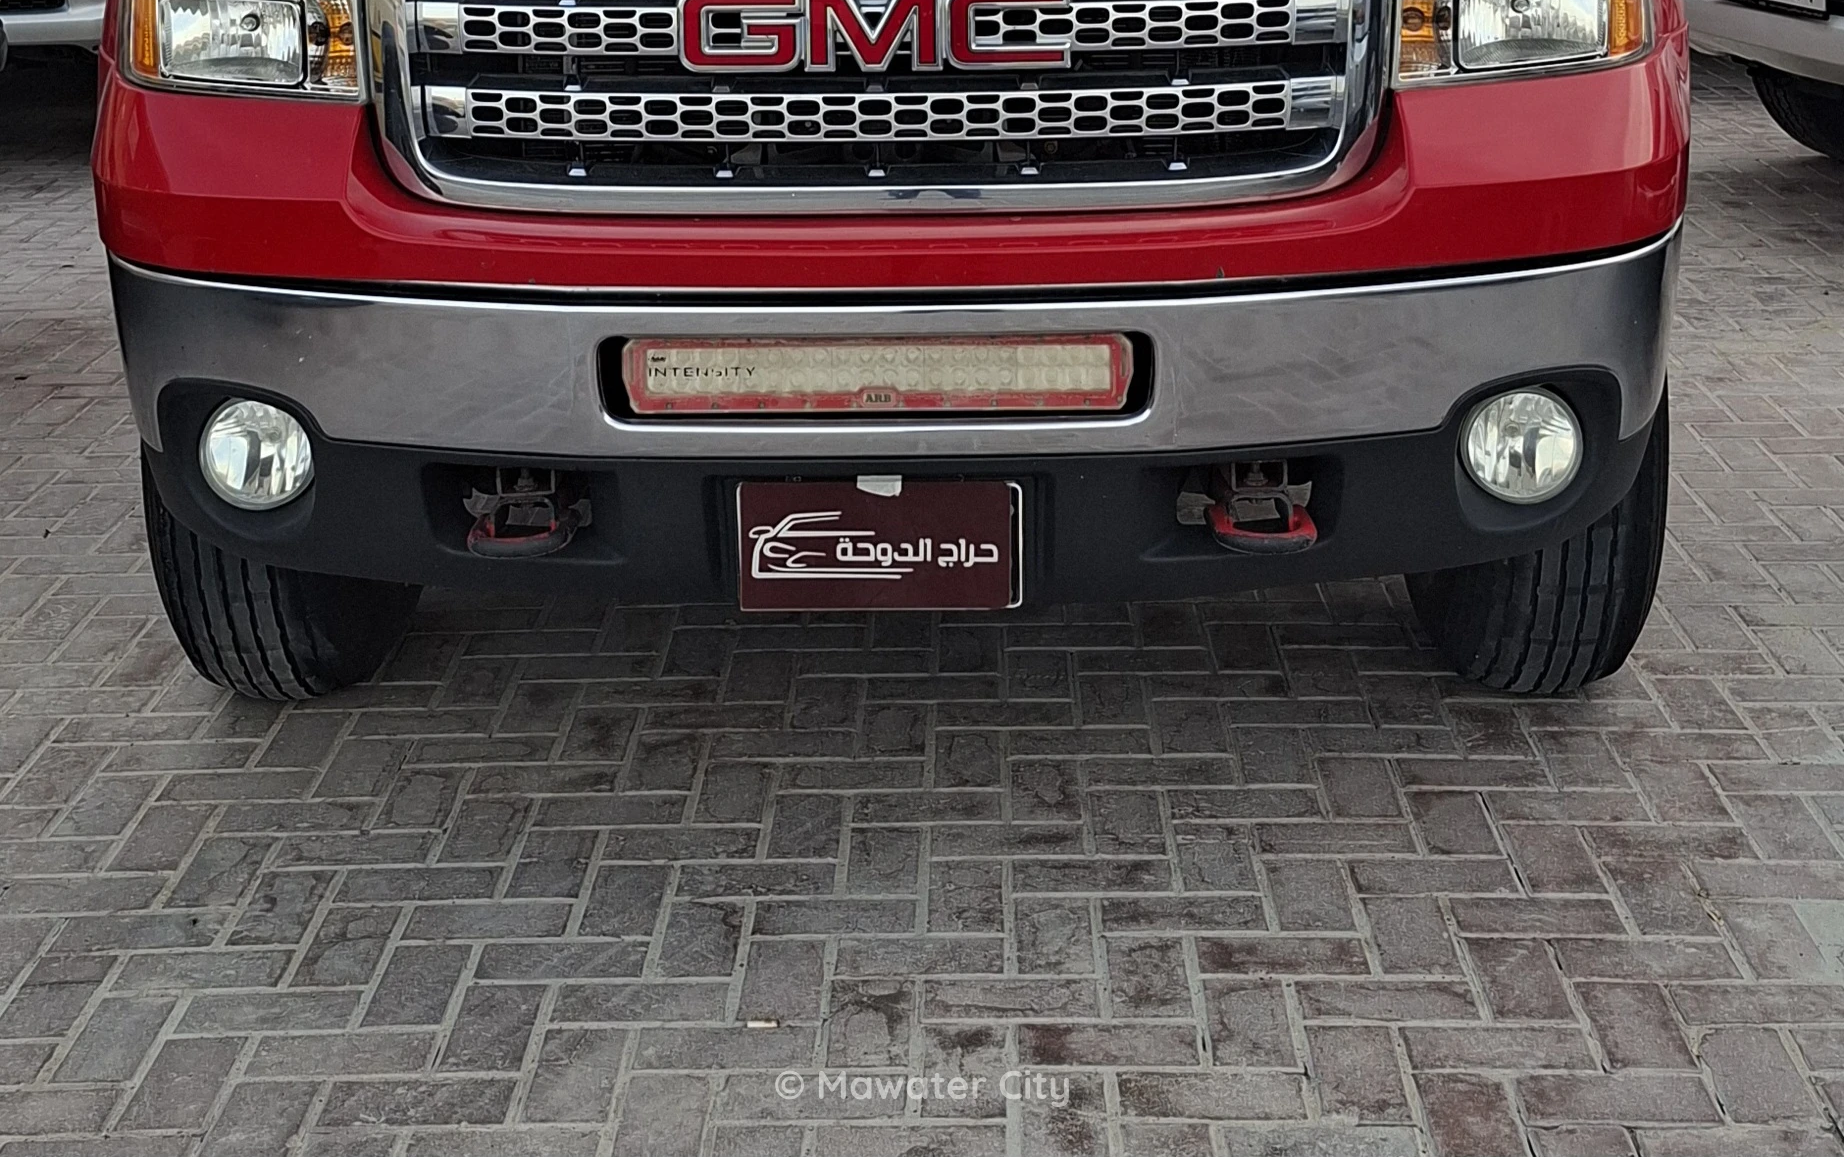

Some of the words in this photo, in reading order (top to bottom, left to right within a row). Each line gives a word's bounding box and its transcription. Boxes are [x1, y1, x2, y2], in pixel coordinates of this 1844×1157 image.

[865, 393, 892, 403] ARB
[836, 537, 932, 567] الدوحة
[936, 538, 999, 567] حراج
